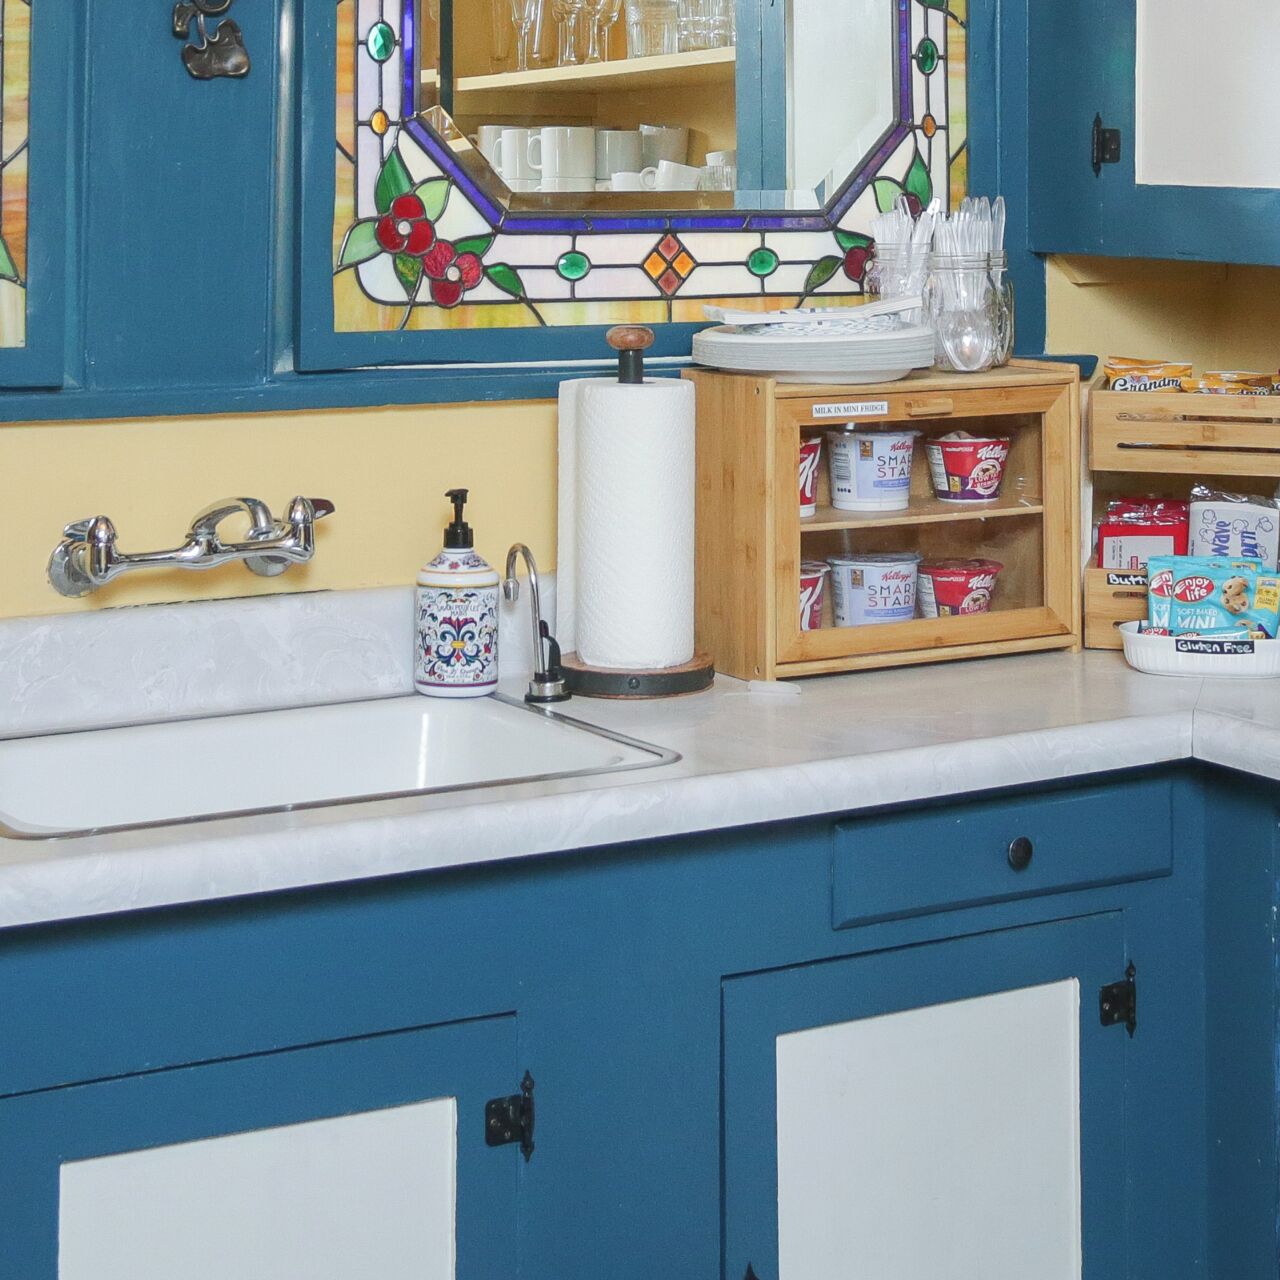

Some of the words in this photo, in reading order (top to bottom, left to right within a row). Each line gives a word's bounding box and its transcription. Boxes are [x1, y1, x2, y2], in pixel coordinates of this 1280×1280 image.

[1111, 376, 1181, 392] Grandm
[814, 406, 833, 415] MILK
[834, 406, 841, 414] IN
[842, 405, 859, 414] MINI
[860, 404, 886, 413] FRIDGE
[1110, 574, 1147, 585] Butt
[1173, 576, 1210, 594] Enjoy
[1185, 588, 1207, 601] life
[1177, 616, 1216, 629] MINI
[1177, 641, 1220, 653] Gluten
[1223, 642, 1253, 654] Free
